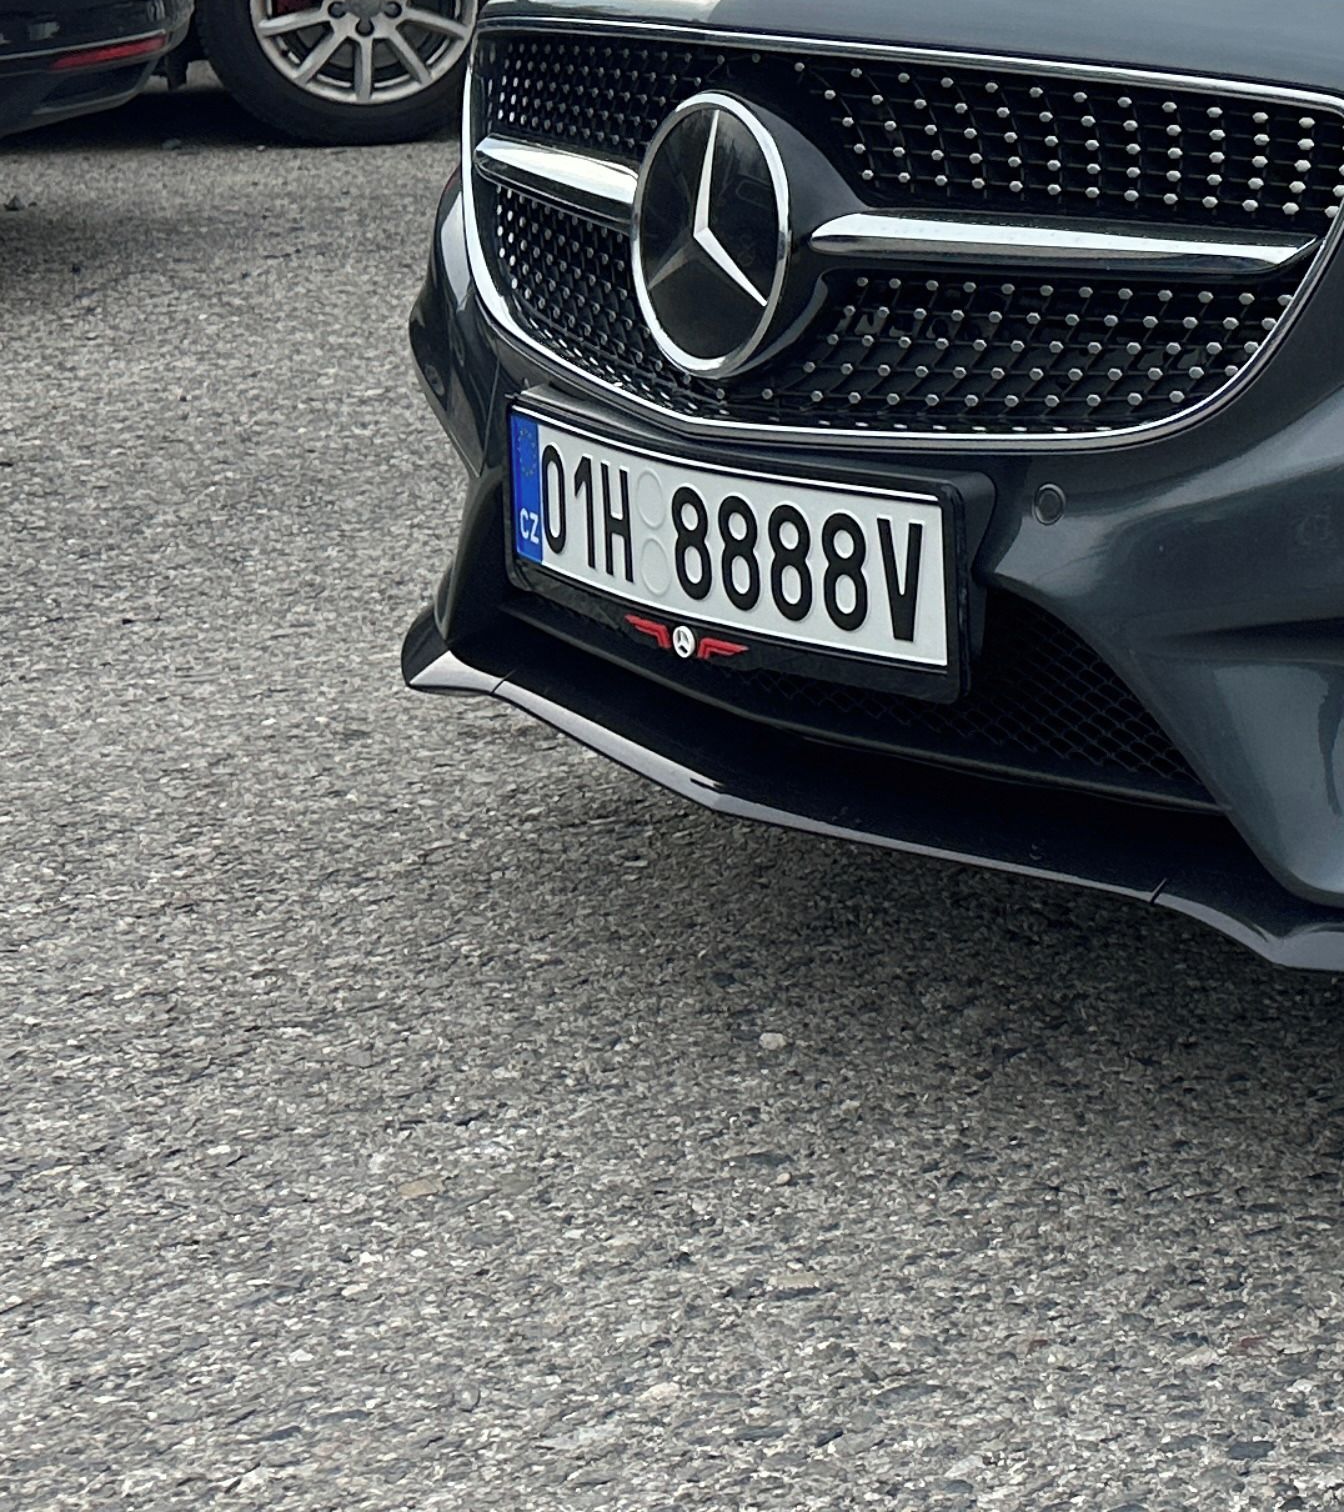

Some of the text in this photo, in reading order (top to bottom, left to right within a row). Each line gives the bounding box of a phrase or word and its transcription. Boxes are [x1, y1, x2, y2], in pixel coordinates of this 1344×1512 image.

[519, 506, 541, 545] CZ
[541, 444, 923, 643] 01H 8888V
